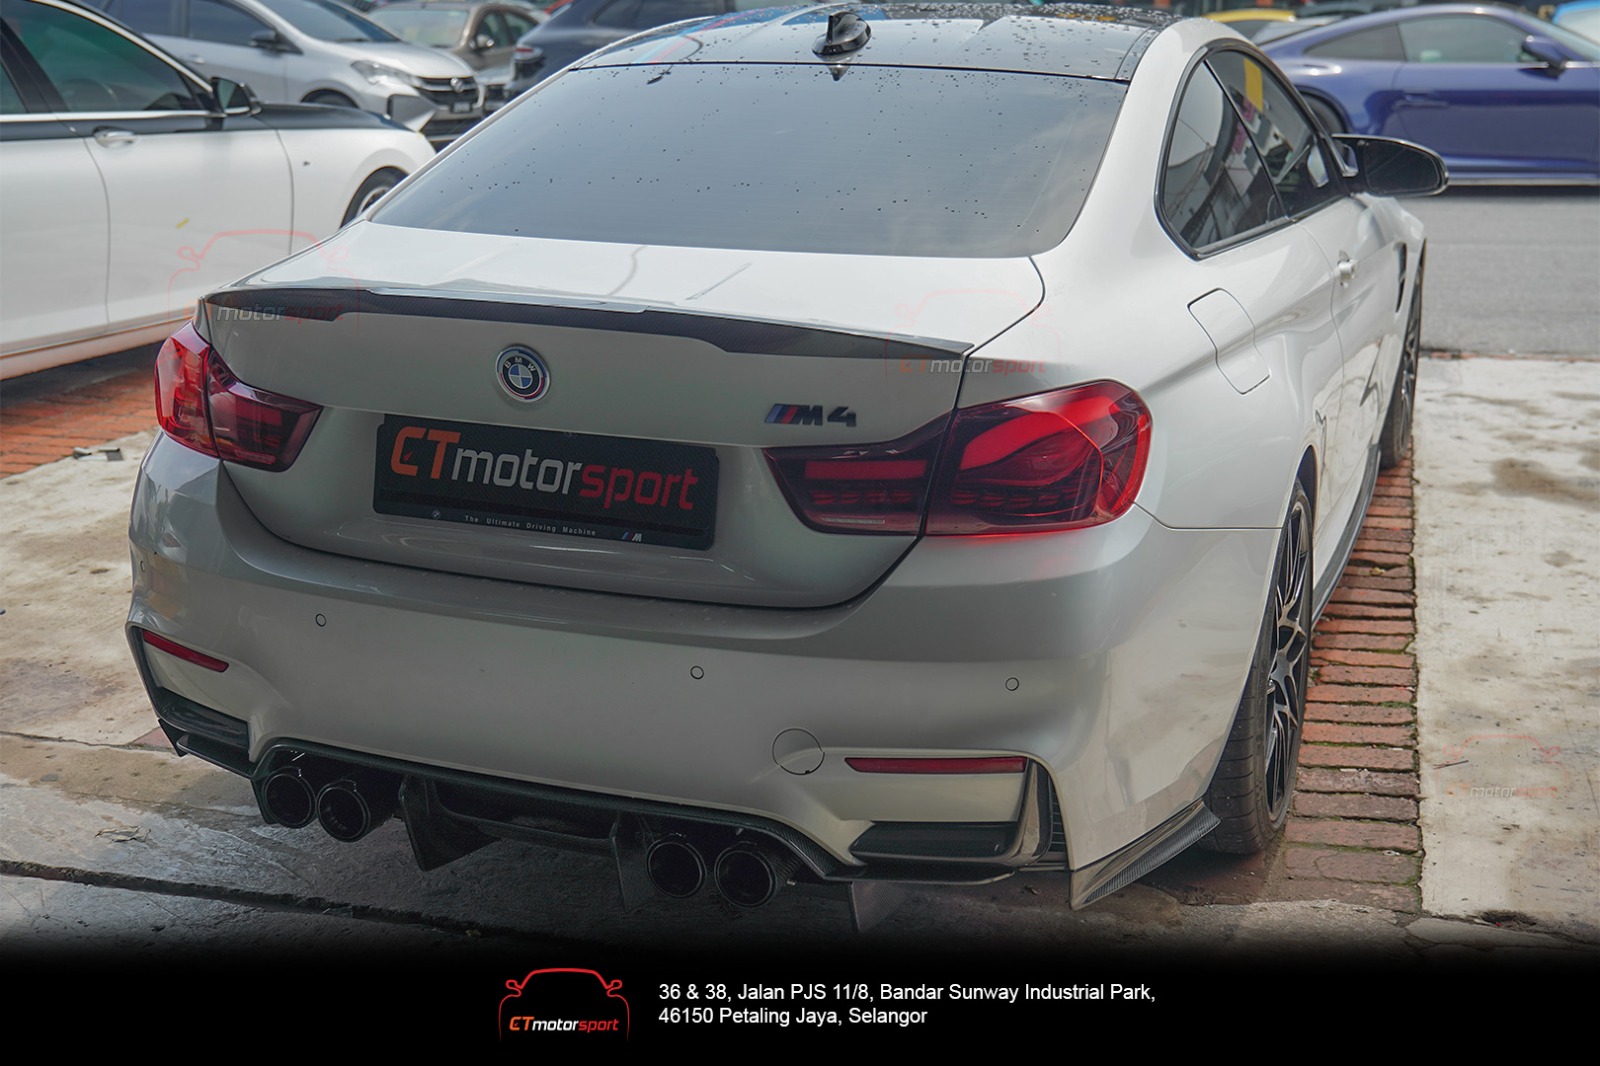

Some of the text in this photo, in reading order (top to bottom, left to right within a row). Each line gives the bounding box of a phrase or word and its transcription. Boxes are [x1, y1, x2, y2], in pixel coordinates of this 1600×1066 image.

[504, 356, 536, 372] BMW
[788, 403, 857, 427] M4
[390, 426, 699, 510] CTmotorsport
[465, 514, 597, 536] The Ultimate Driving Machine
